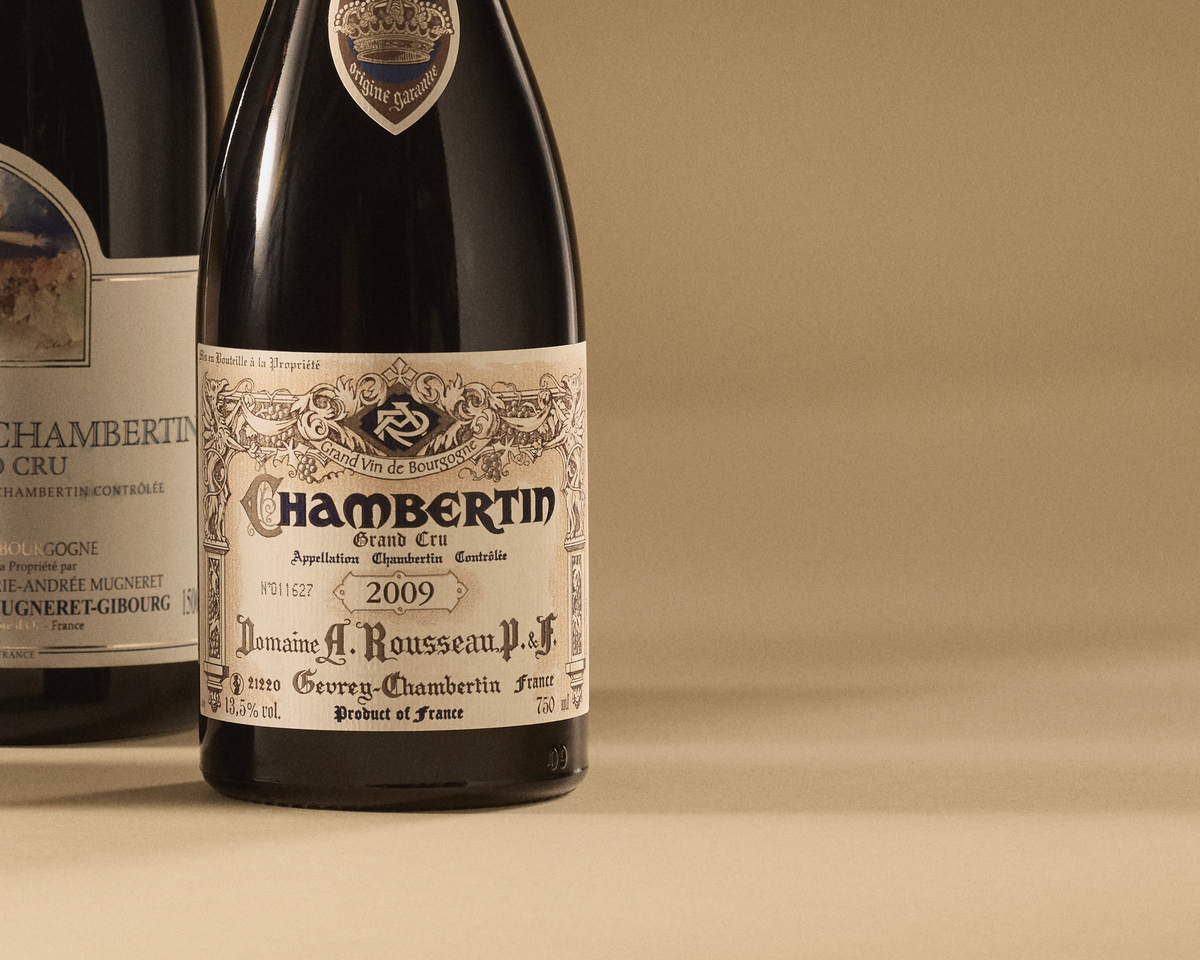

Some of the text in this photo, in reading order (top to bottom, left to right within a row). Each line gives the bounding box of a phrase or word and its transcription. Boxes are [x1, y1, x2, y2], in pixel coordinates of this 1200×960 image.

[349, 62, 391, 104] origine
[215, 351, 248, 367] Bouteille
[250, 356, 255, 367] à
[258, 356, 266, 368] la
[270, 356, 321, 372] Propriété
[12, 456, 68, 476] CRU
[321, 440, 478, 474] Grand Vin de Bourgogne
[94, 481, 165, 498] CONTRÔLÉE
[0, 541, 99, 557] BOURGOGNE
[353, 531, 448, 548] Grand Cru
[8, 560, 58, 575] Propriété
[61, 562, 78, 574] par
[290, 550, 508, 567] Appellation Chambertin Contrôlée
[90, 574, 164, 591] MUGNERET
[366, 581, 435, 606] 2009
[51, 620, 85, 631] France
[235, 614, 321, 659] Domaine
[355, 621, 500, 664] Rousseau
[248, 668, 555, 705] 21220 Gevrey-Chambertin France
[225, 696, 282, 720] 13,5% vol.
[334, 705, 464, 723] Product of France
[536, 694, 570, 715] 750 ml
